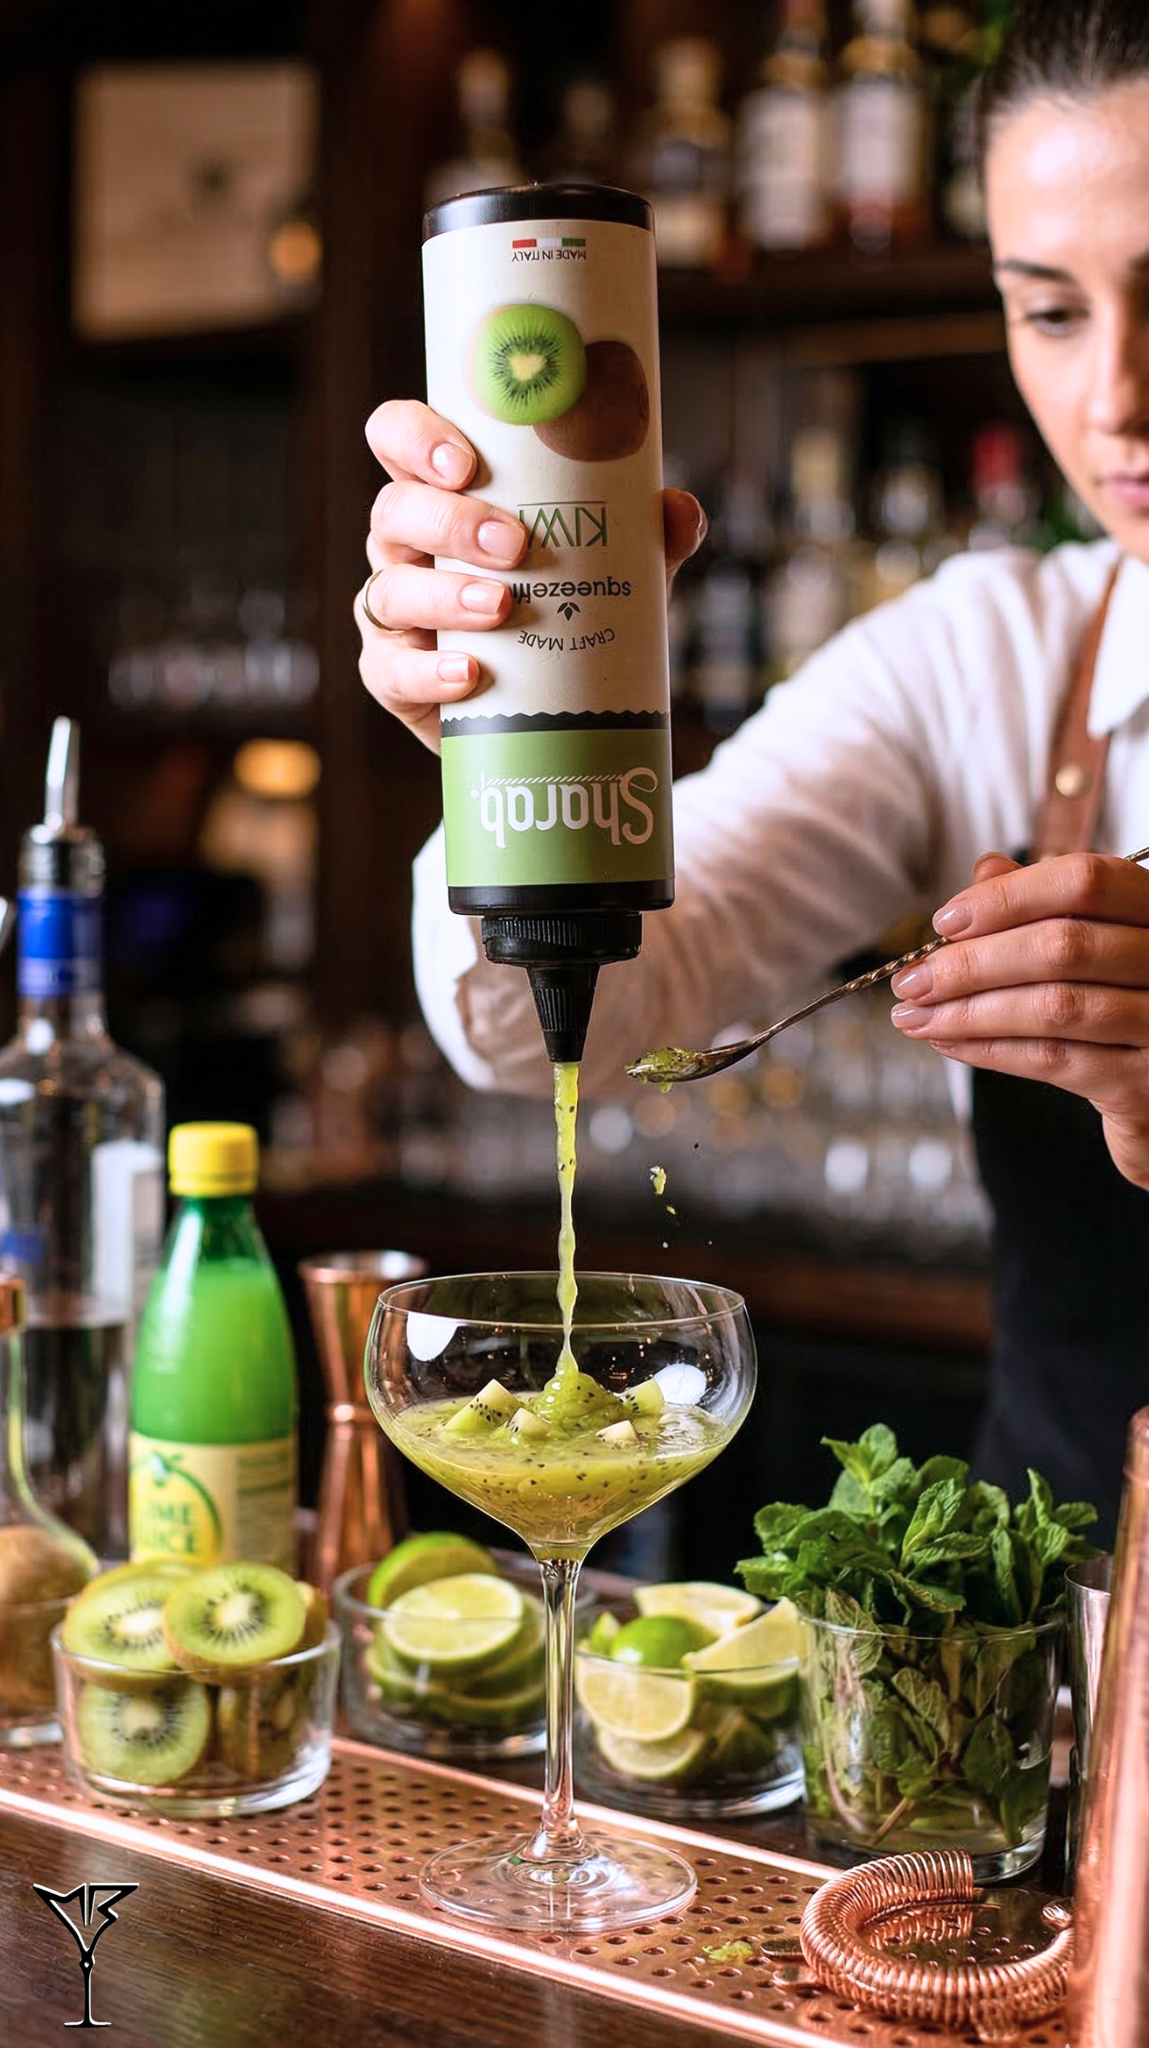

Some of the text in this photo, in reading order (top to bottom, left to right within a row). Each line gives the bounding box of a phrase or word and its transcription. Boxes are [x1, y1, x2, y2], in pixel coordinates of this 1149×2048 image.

[511, 249, 587, 262] MADE IN ITALY
[517, 628, 616, 651] CRAFT MADE
